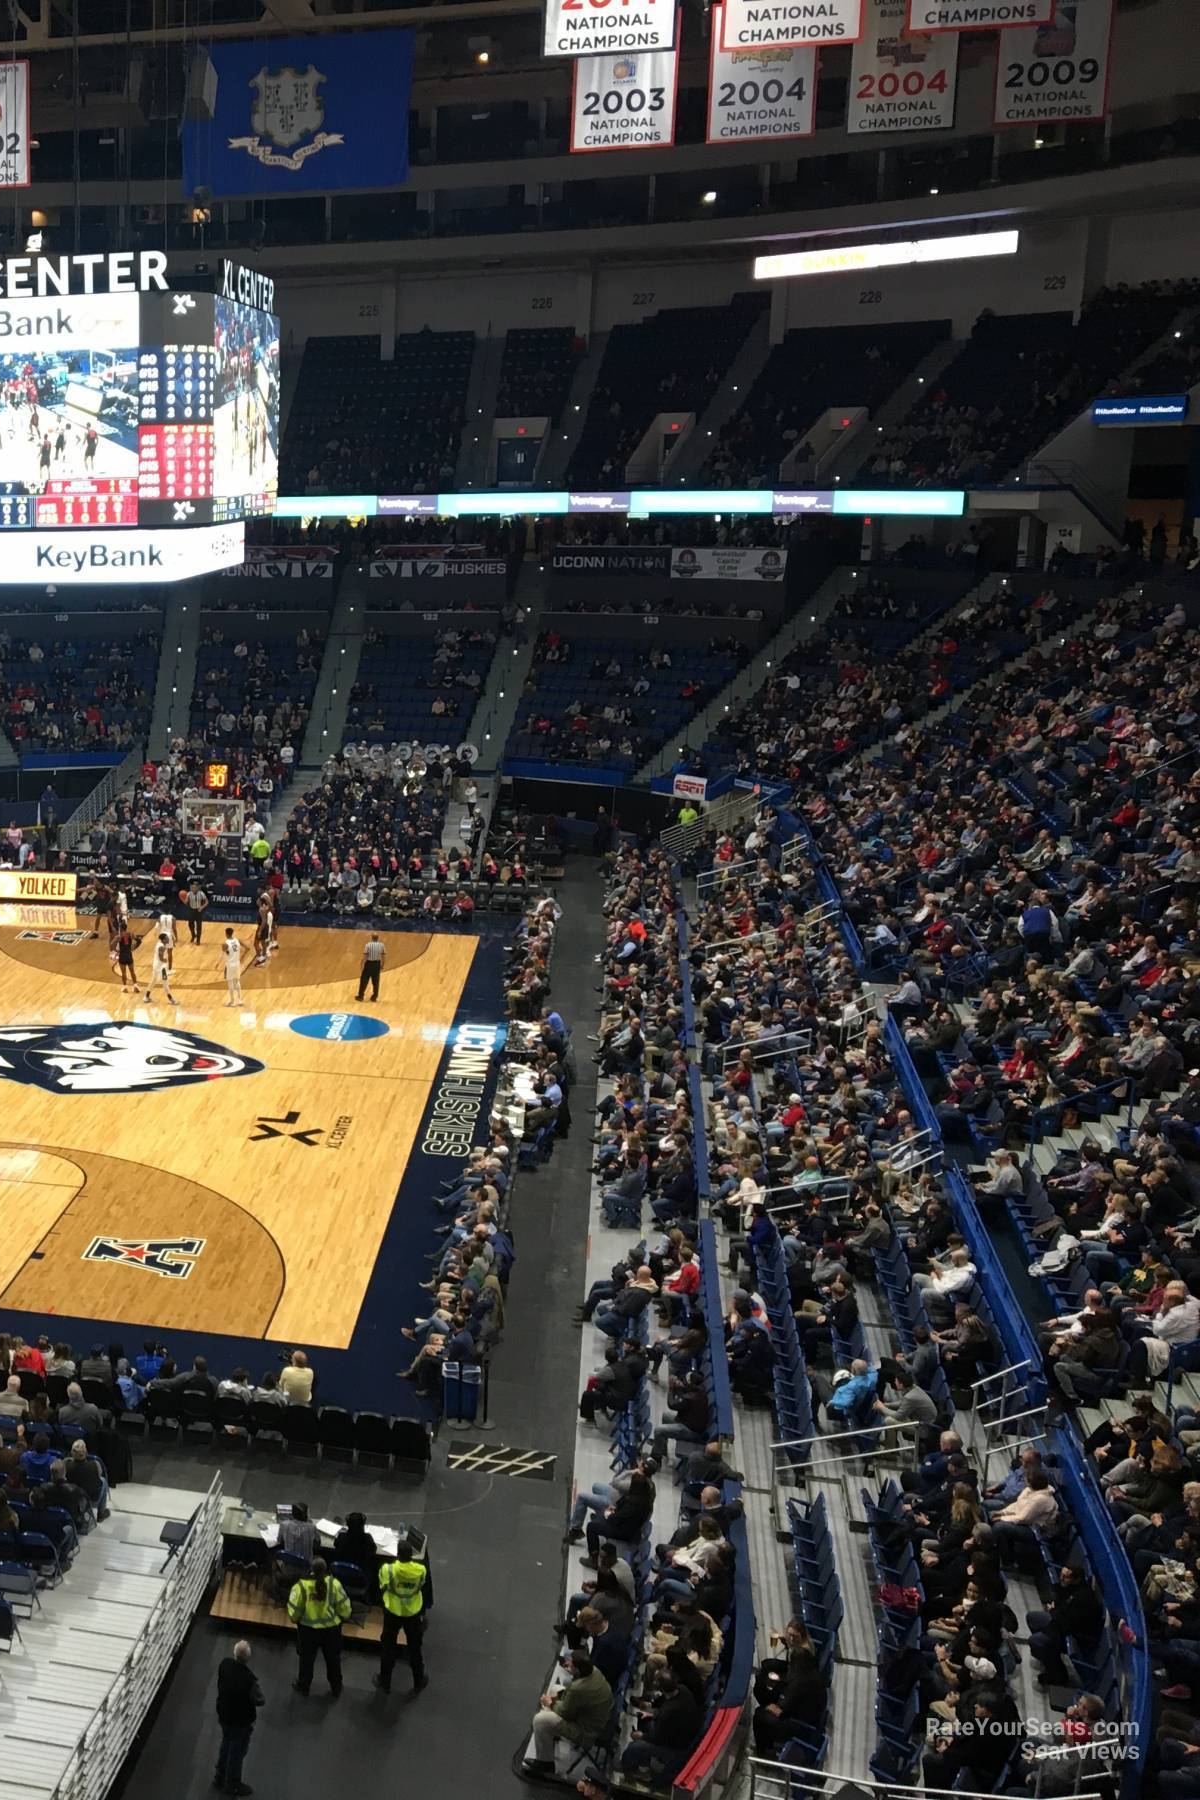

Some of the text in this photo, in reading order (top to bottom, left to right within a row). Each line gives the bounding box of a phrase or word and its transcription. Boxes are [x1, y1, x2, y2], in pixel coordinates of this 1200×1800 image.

[747, 4, 839, 23] NATIONAL
[925, 5, 1037, 25] CHAMPIONS
[566, 13, 653, 31] NATIONAL
[738, 23, 845, 43] CHAMPIONS
[558, 32, 660, 51] CHAMPIONS
[1004, 58, 1099, 88] 2009
[856, 69, 948, 99] 2004
[718, 77, 807, 107] 2004
[1013, 91, 1088, 103] NATIONAL
[582, 88, 666, 116] 2003
[865, 101, 937, 113] NATIONAL
[726, 107, 796, 122] NATIONAL
[1006, 105, 1093, 119] CHAMPIONS
[590, 117, 657, 131] NATIONAL
[719, 122, 801, 137] CHAMPIONS
[858, 115, 942, 129] CHAMPIONS
[584, 132, 662, 146] CHAMPIONS
[222, 258, 274, 314] XL CENTER
[632, 293, 655, 305] 227
[36, 544, 164, 572] KeyBank
[552, 556, 605, 568] UCONN
[443, 563, 506, 576] HUSKIES
[209, 774, 225, 787] 30
[675, 780, 704, 795] ESPN
[71, 854, 100, 865] Hartfor
[19, 876, 67, 896] YOLKED
[212, 894, 252, 904] TRAVELERS
[421, 1023, 498, 1158] UCONN HUSKIES
